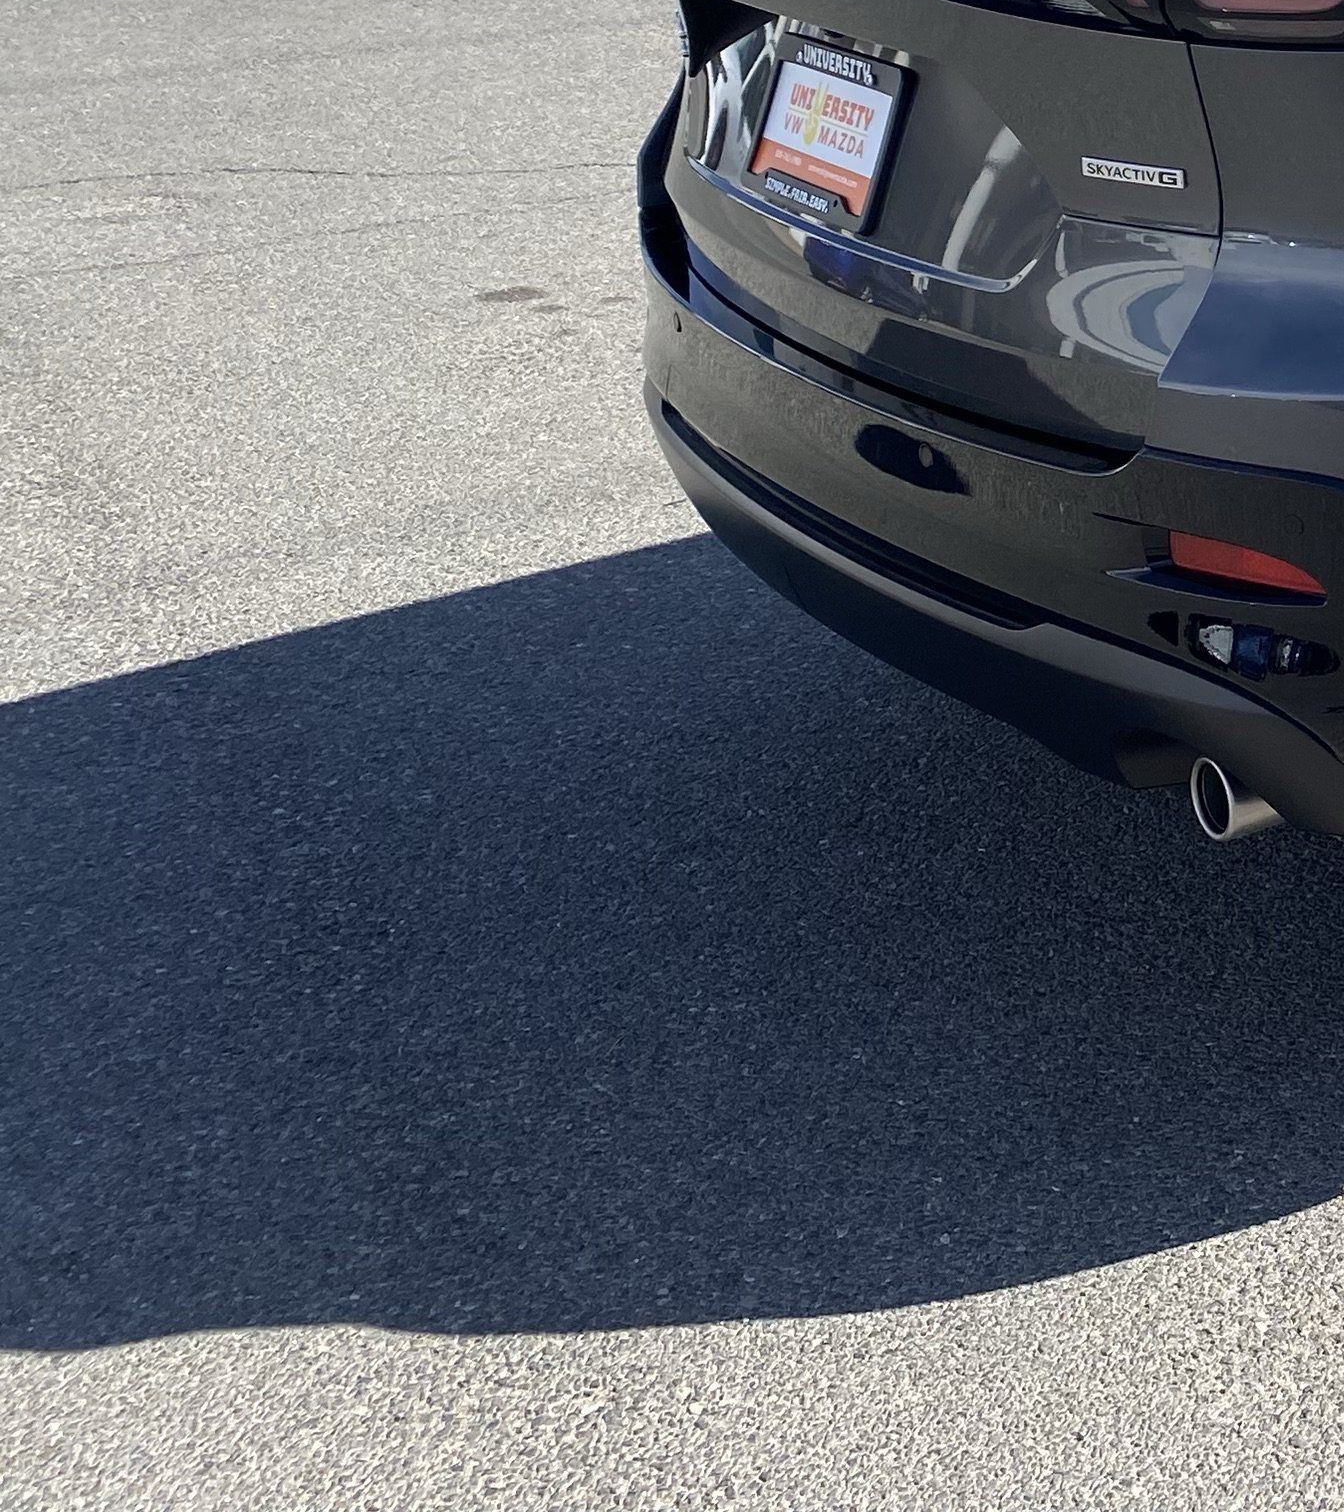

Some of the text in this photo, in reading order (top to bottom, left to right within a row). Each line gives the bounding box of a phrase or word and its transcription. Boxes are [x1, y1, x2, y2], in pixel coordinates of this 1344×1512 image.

[803, 44, 873, 83] UNIVERSITY
[784, 112, 804, 135] VW
[817, 125, 865, 159] MAZDA
